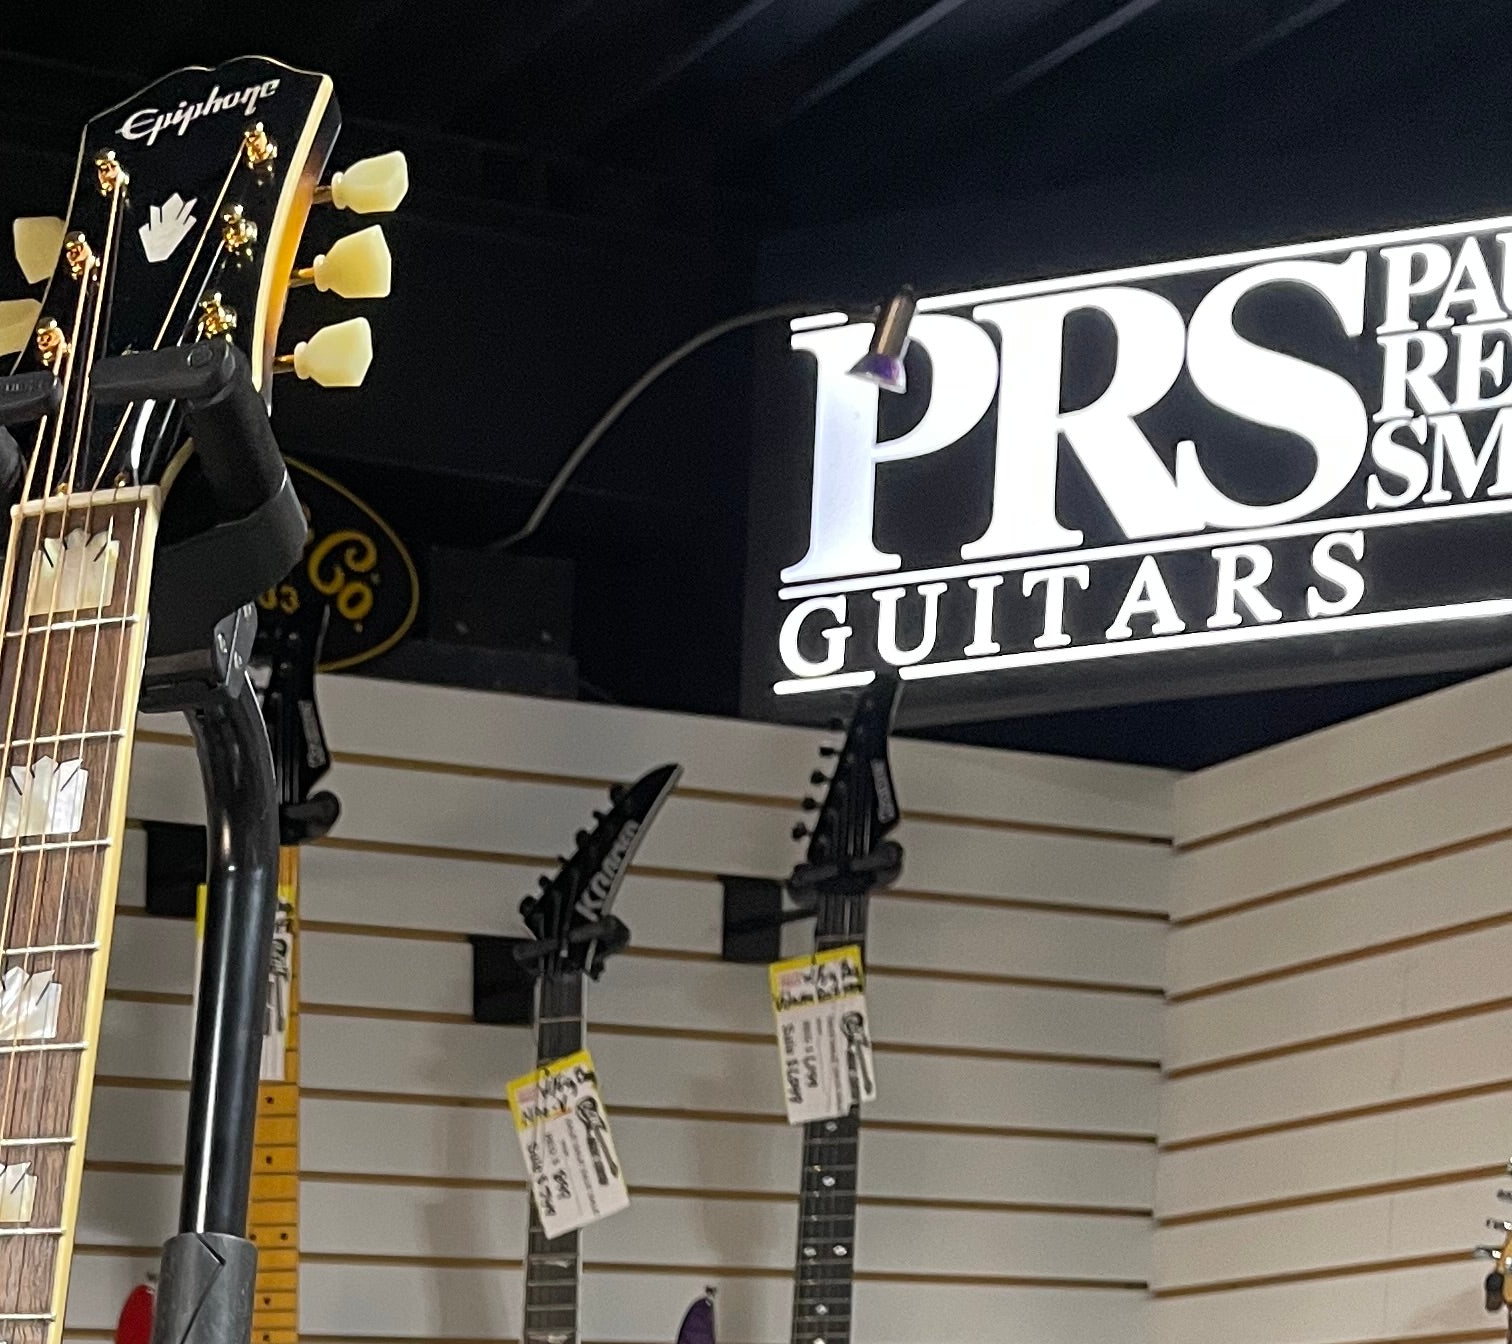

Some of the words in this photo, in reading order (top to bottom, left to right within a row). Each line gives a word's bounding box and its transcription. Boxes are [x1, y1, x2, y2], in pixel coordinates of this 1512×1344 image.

[115, 78, 280, 146] Epiphone
[780, 250, 1368, 584] PRS
[777, 529, 1366, 677] GUITARS
